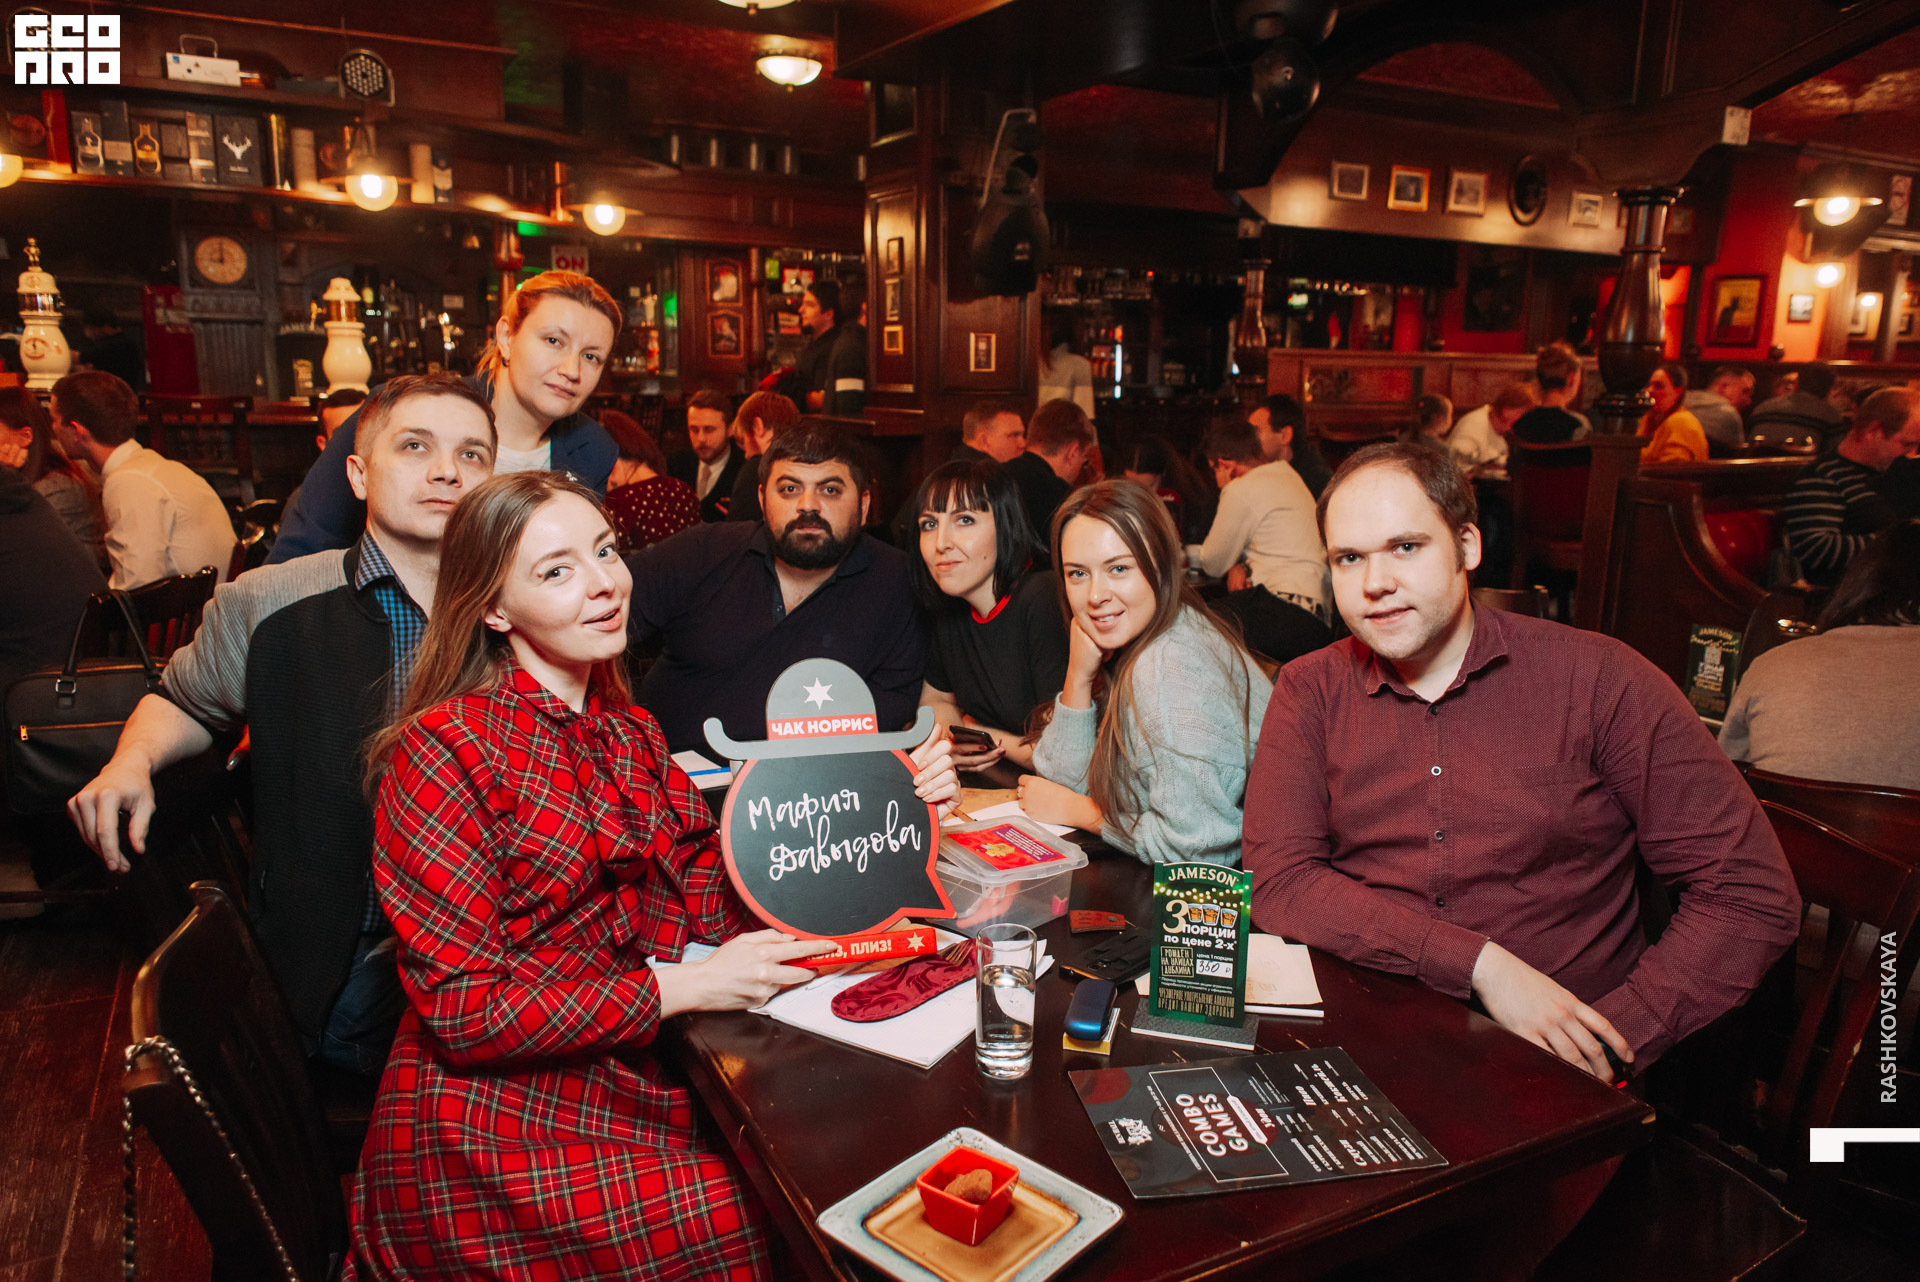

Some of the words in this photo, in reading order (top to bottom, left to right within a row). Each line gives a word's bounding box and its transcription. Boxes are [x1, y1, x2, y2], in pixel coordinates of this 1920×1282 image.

[771, 722, 804, 736] ЧАК
[807, 717, 874, 734] НОРРИС
[748, 789, 860, 839] Мафия
[769, 800, 921, 881] Давыдова
[1168, 867, 1237, 887] JAMESON
[1163, 899, 1189, 934] 3
[1164, 935, 1179, 943] по
[1182, 937, 1212, 947] цене
[1182, 924, 1236, 939] ПОРЦИИ
[850, 939, 892, 955] ПЛИЗ!
[1175, 1093, 1227, 1157] COMBO
[1198, 1093, 1250, 1151] GAMES
